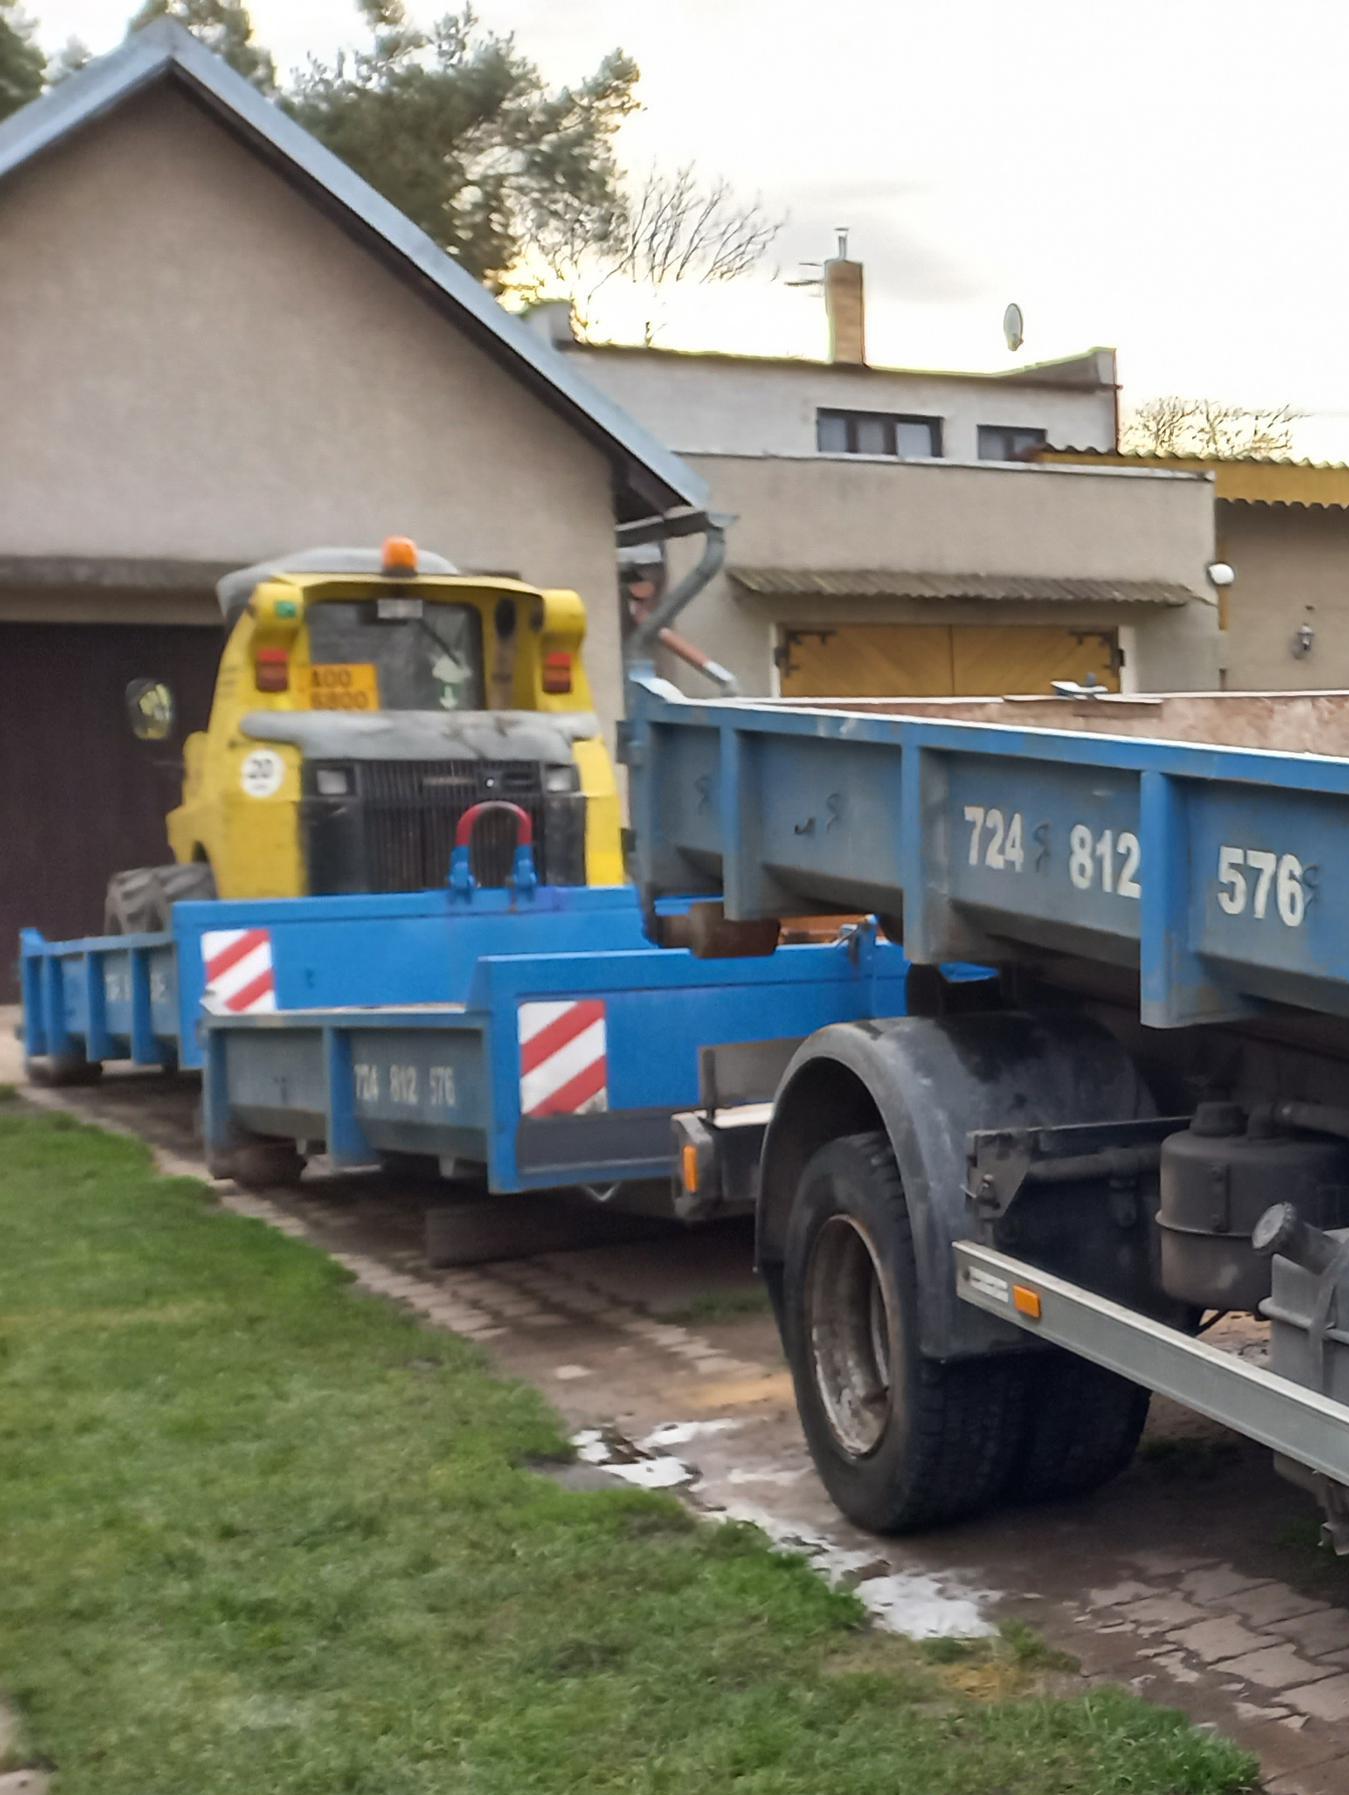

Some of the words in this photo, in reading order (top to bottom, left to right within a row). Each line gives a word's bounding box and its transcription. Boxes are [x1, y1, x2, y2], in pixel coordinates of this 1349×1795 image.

[964, 806, 1025, 872] 724
[1069, 824, 1142, 899] 812
[1217, 845, 1303, 927] 576
